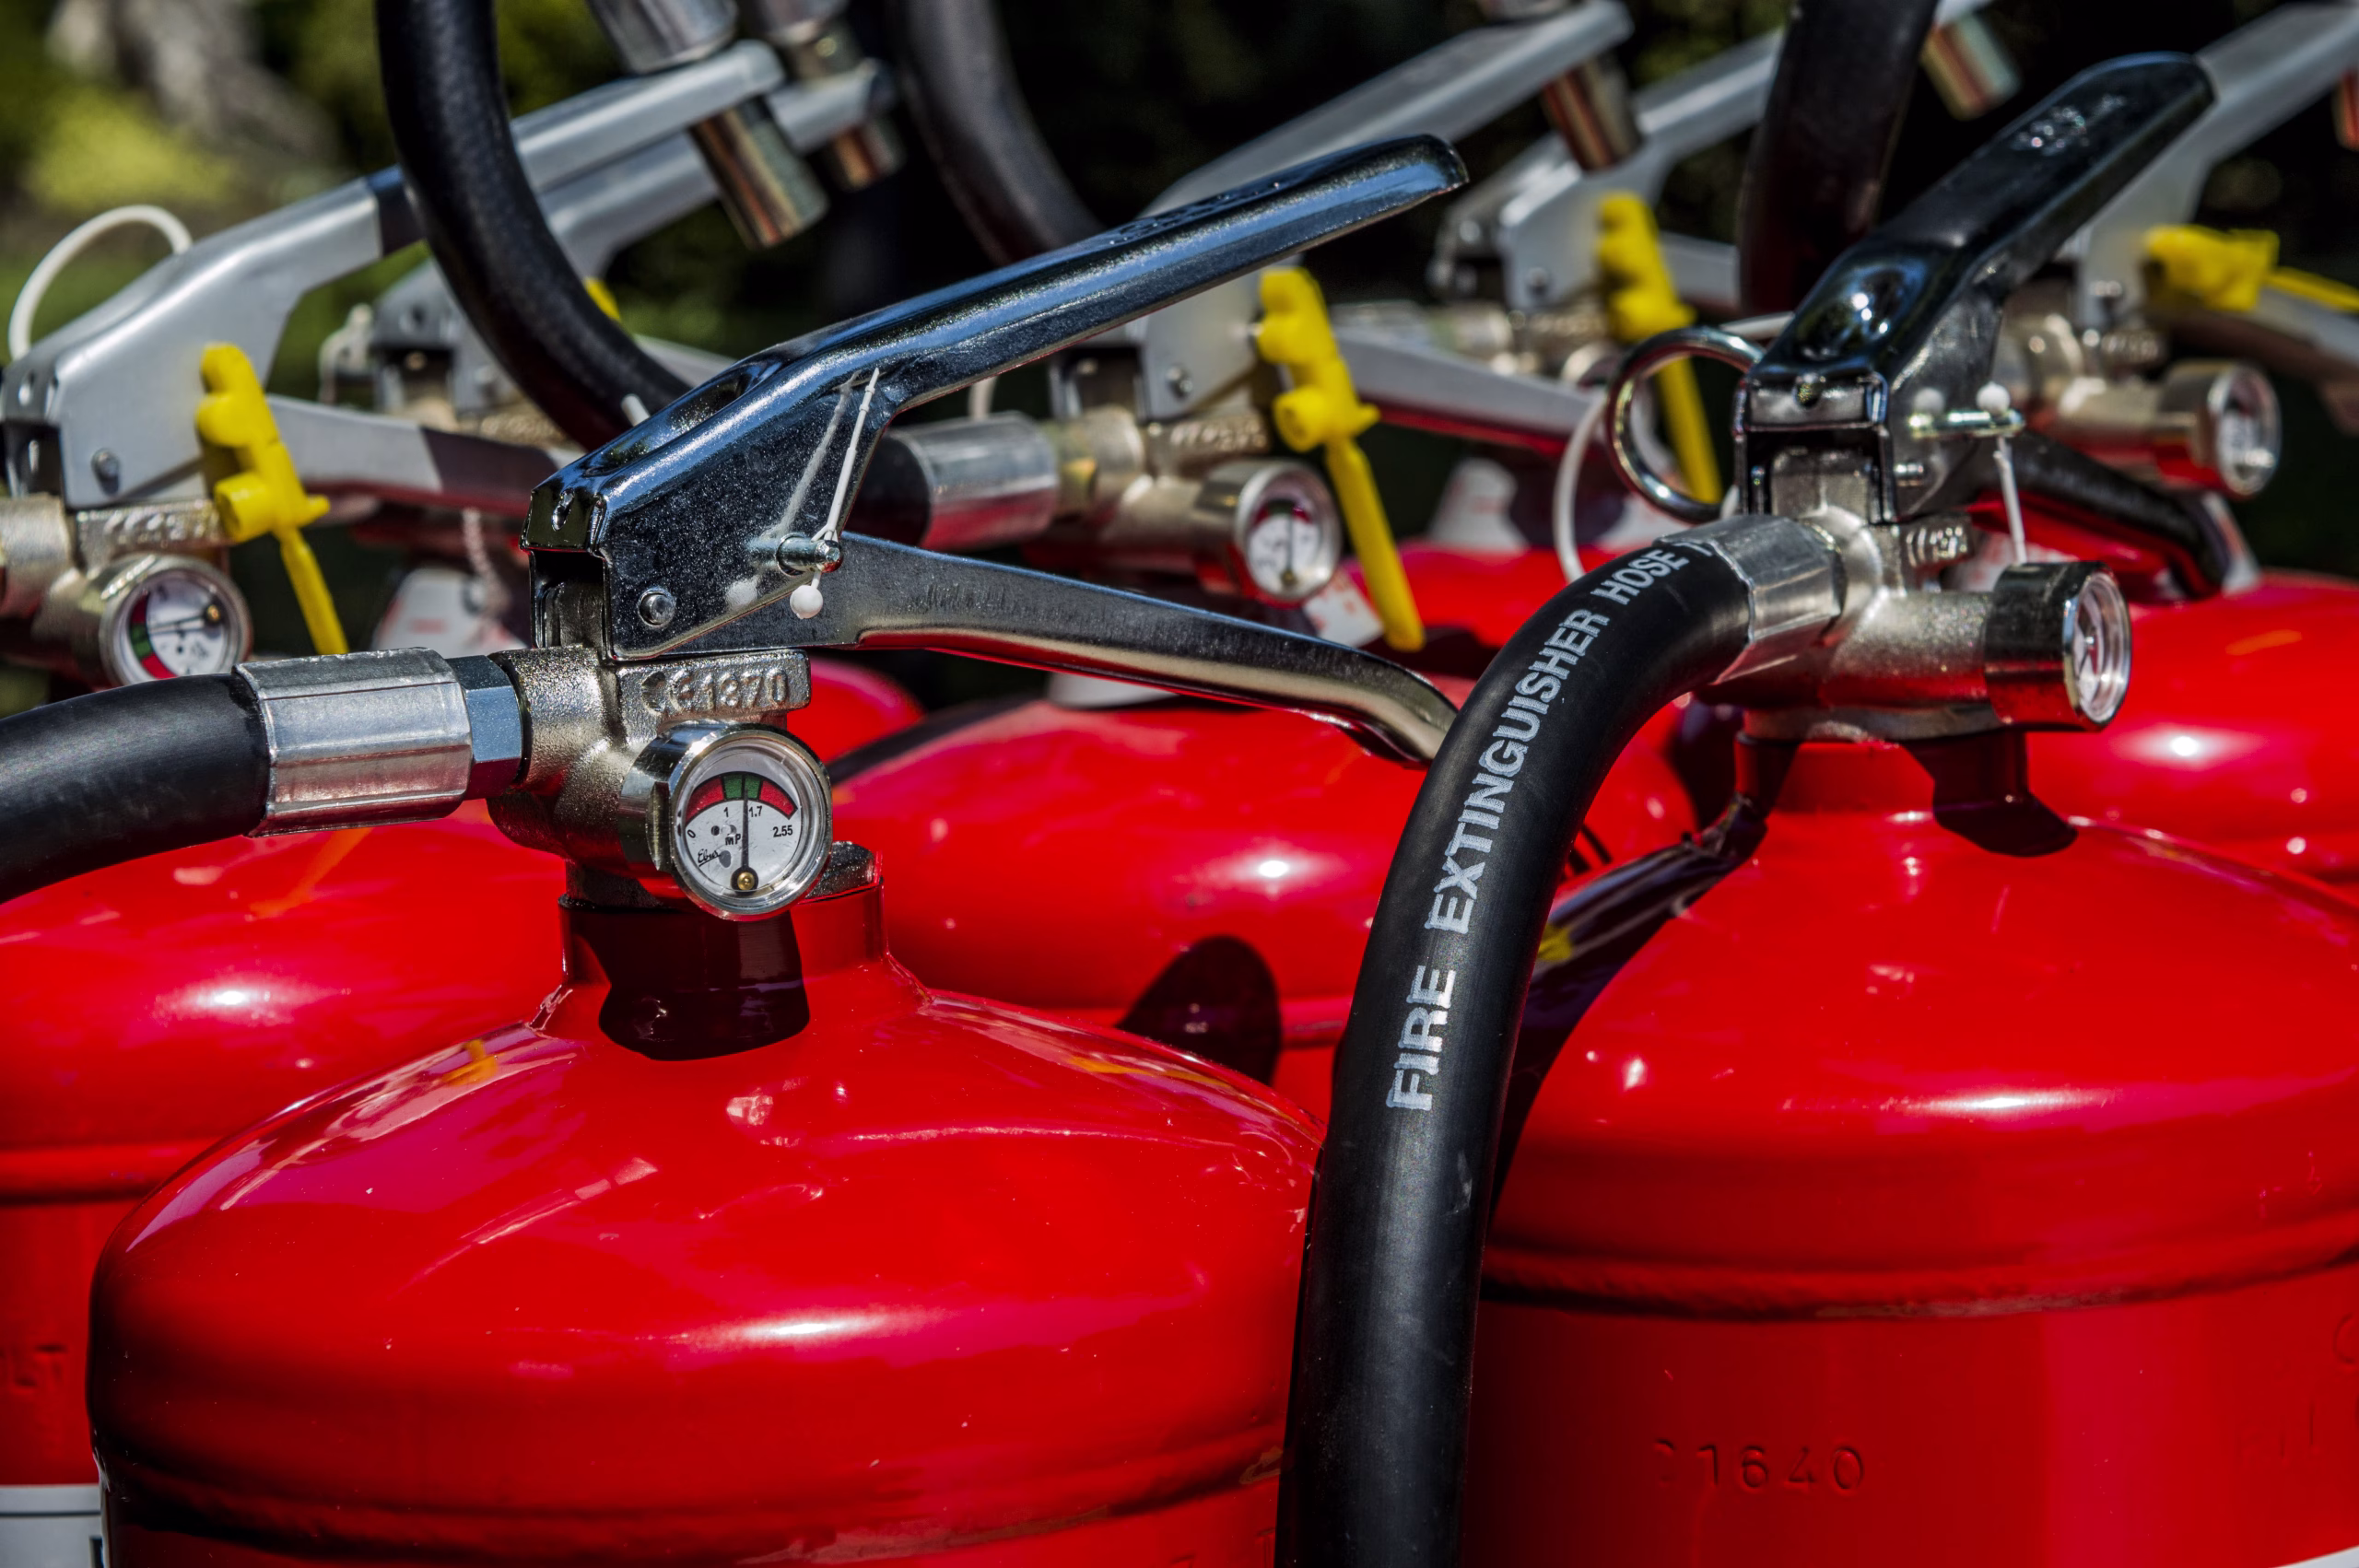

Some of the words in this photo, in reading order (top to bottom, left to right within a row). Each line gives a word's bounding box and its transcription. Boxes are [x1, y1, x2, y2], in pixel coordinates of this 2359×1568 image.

[749, 805, 763, 817] 1.7
[772, 825, 793, 837] 2.55
[1386, 965, 1457, 1111] FIRE
[1424, 608, 1611, 934] EXTINGUISHER
[1590, 549, 1690, 605] HOSE
